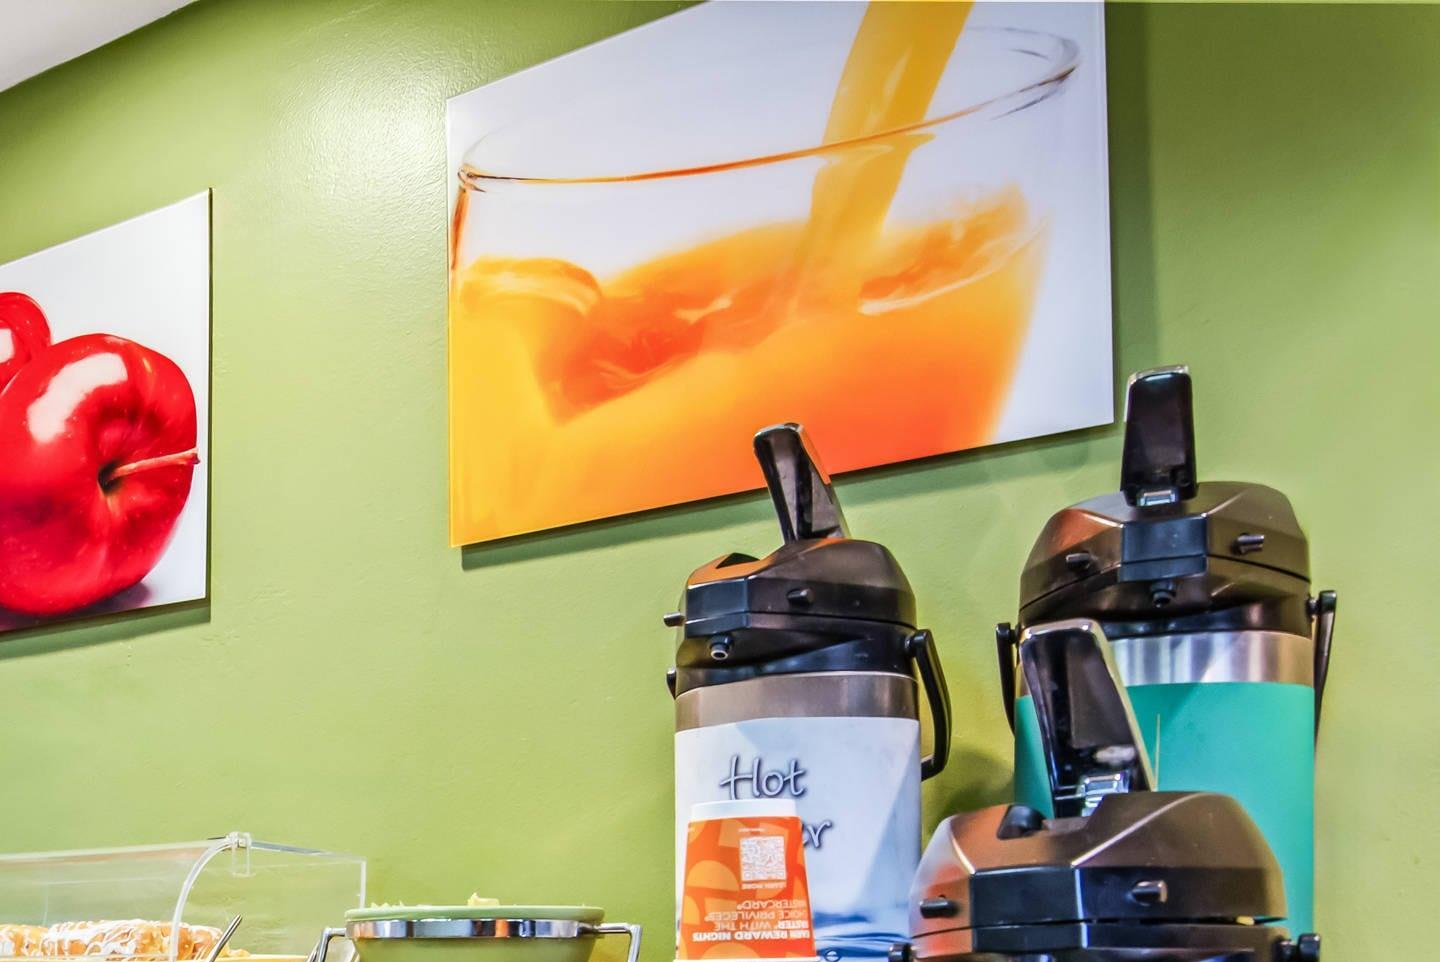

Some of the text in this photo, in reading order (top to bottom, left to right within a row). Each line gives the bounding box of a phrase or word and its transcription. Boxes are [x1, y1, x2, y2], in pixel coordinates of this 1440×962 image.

[719, 755, 806, 800] Hot
[714, 921, 736, 931] THE
[740, 920, 771, 930] WITH
[692, 931, 731, 942] NIGHTS
[735, 930, 788, 940] REWARD
